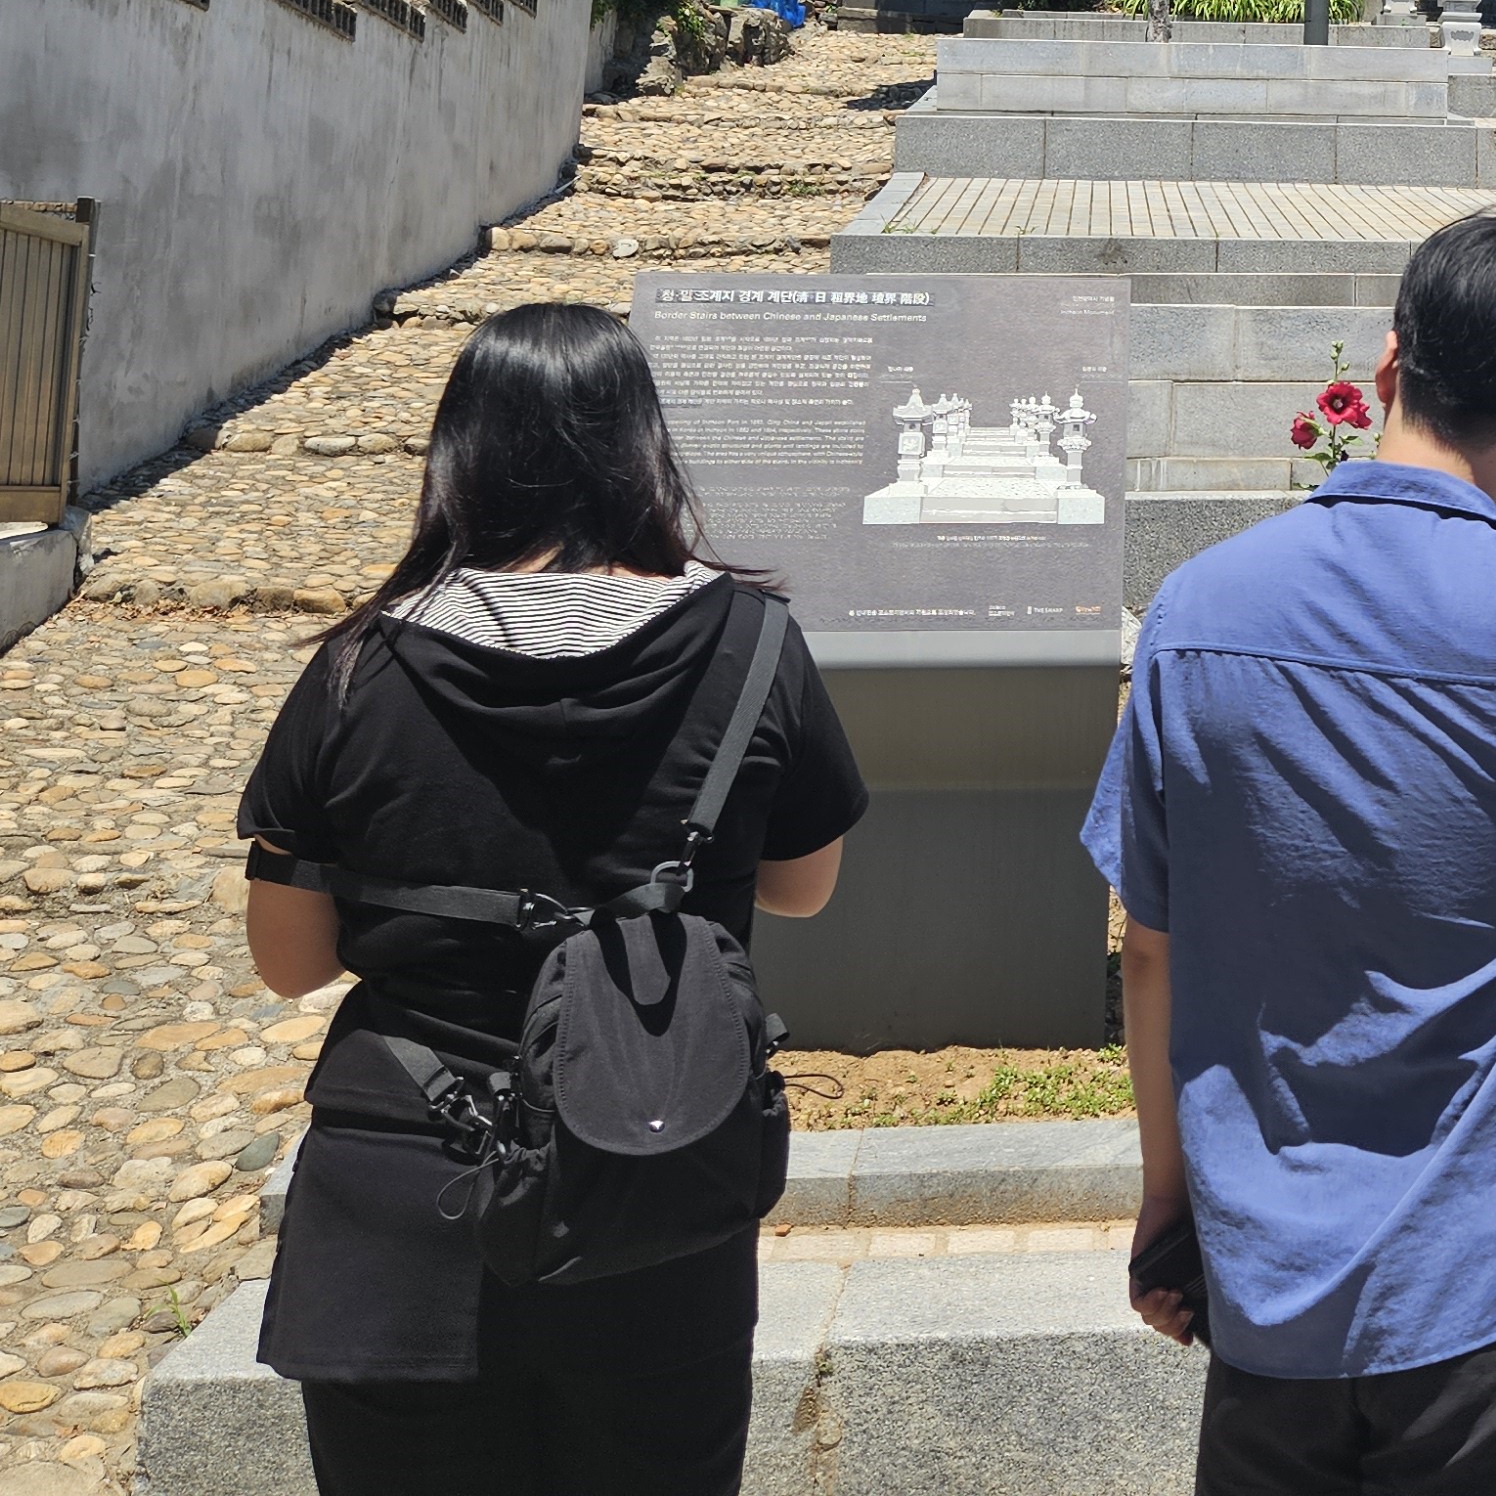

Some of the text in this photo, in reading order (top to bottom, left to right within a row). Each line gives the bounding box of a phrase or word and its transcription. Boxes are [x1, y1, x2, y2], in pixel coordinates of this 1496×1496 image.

[739, 290, 763, 302] 경계
[654, 310, 927, 323] Border Stairs between Chinese and Japanese Settlements
